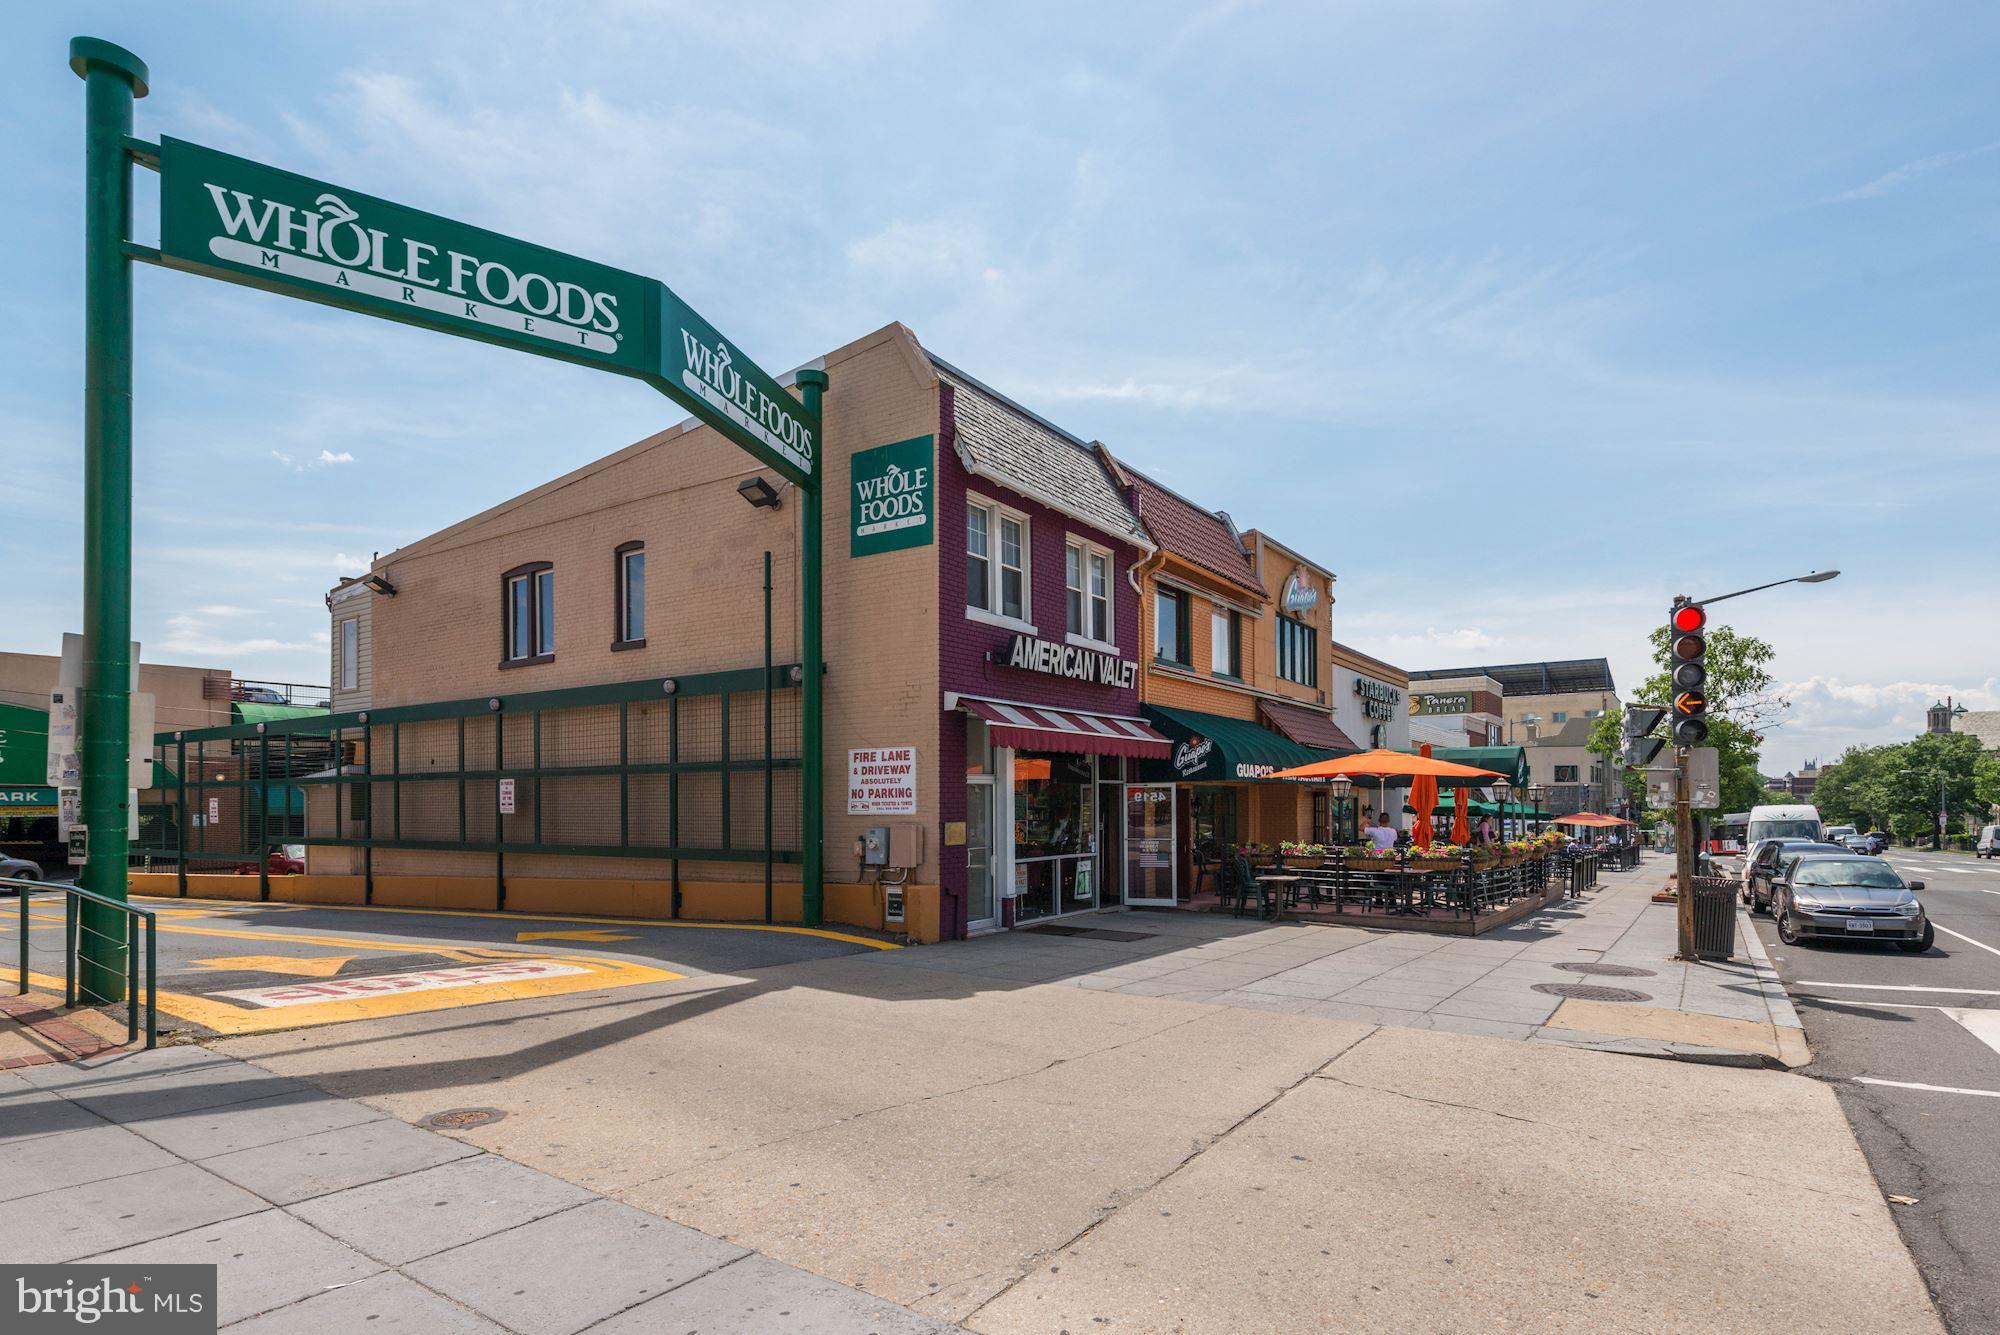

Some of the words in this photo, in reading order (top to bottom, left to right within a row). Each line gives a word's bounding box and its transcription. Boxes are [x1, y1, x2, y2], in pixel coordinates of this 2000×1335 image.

[204, 183, 440, 286] WHOLE
[448, 250, 619, 332] FOODS
[261, 251, 589, 345] MARKET
[681, 328, 757, 417] WHOLE
[759, 392, 813, 459] FOODS
[700, 384, 803, 467] MARKET
[856, 464, 928, 501] WHOLE
[860, 491, 923, 524] FOODS
[860, 517, 923, 534] MARKET
[1010, 635, 1095, 682] AMERICAN
[1099, 655, 1138, 690] VALET
[1424, 695, 1466, 706] Panera
[1428, 706, 1464, 714] BREAD
[853, 751, 877, 763] FIRE
[881, 750, 911, 762] LANE
[853, 767, 858, 775] &
[861, 764, 912, 776] DRIVEWAY
[1236, 763, 1274, 779] GUAPO'S
[860, 777, 902, 785] ABSOLUTELY
[851, 788, 864, 799] NO
[868, 787, 913, 799] PARKING
